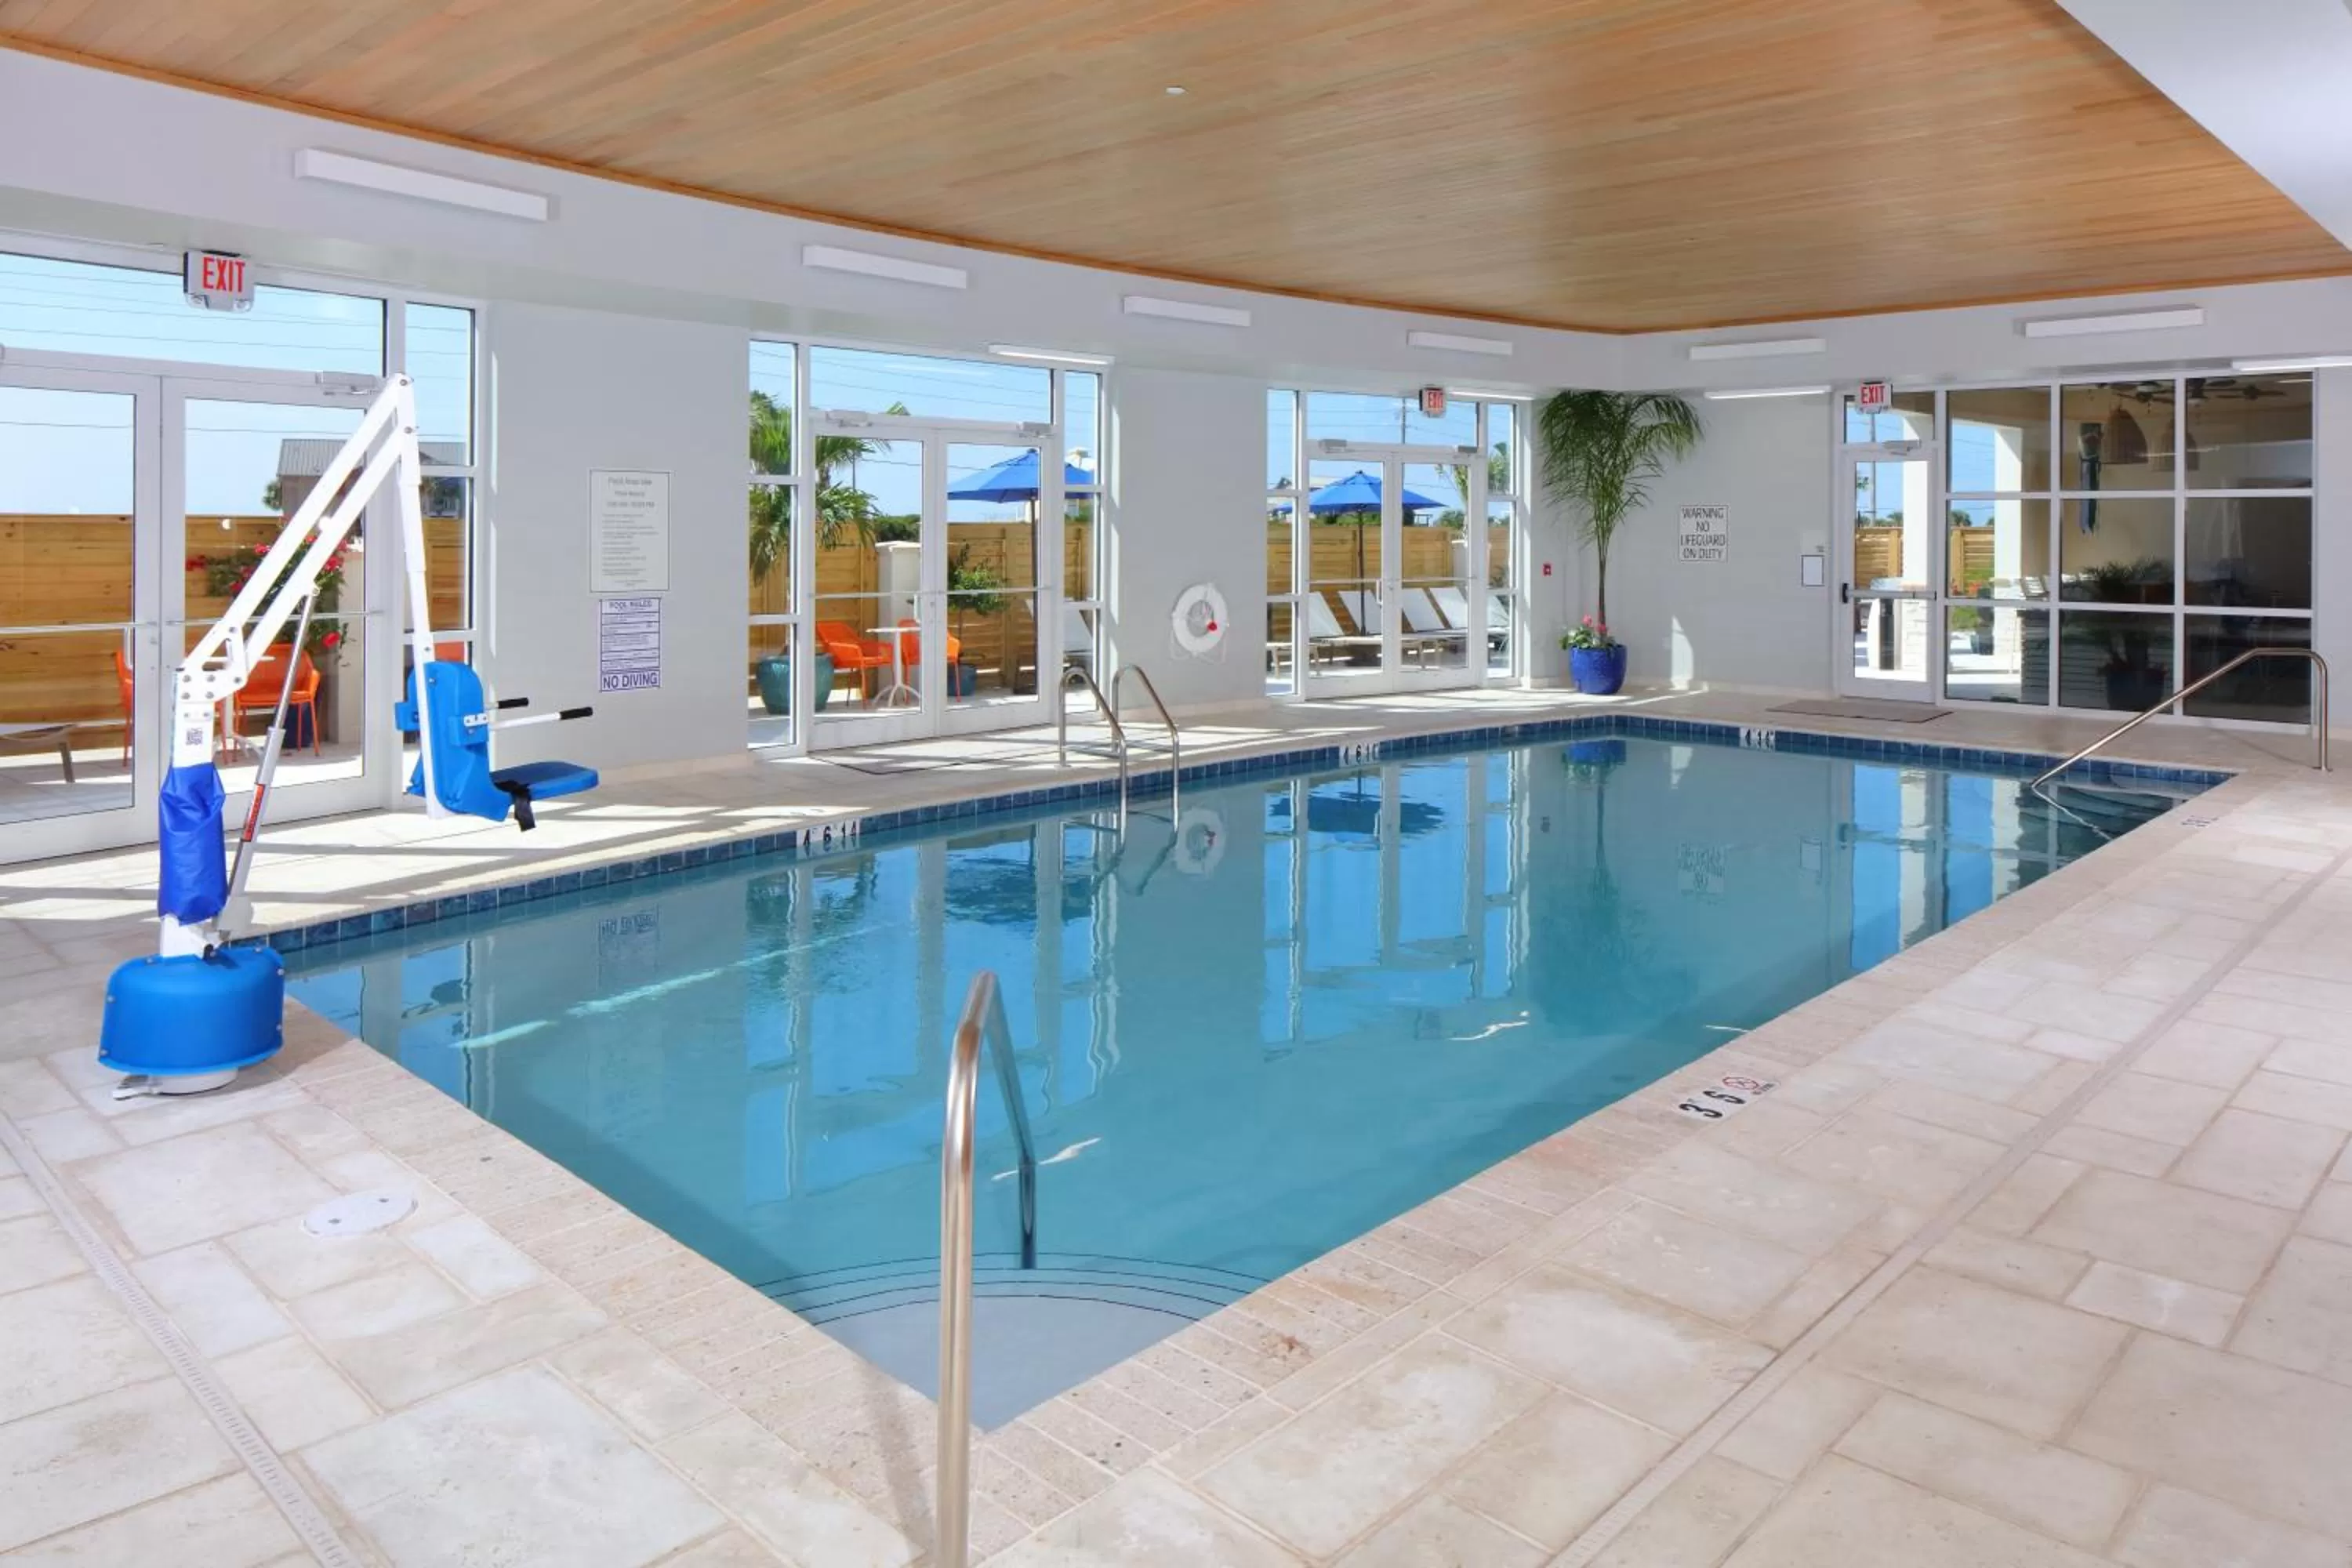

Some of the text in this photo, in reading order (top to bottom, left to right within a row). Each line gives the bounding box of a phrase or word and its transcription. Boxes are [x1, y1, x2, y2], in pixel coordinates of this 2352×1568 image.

[202, 256, 246, 293] EXIT
[1861, 385, 1886, 404] EXIT
[1682, 507, 1725, 518] WARNING
[1696, 521, 1710, 532] NO
[1680, 534, 1726, 546] LIFEGUARD
[1682, 548, 1722, 559] ON DUTY
[603, 672, 658, 689] NO DIVING
